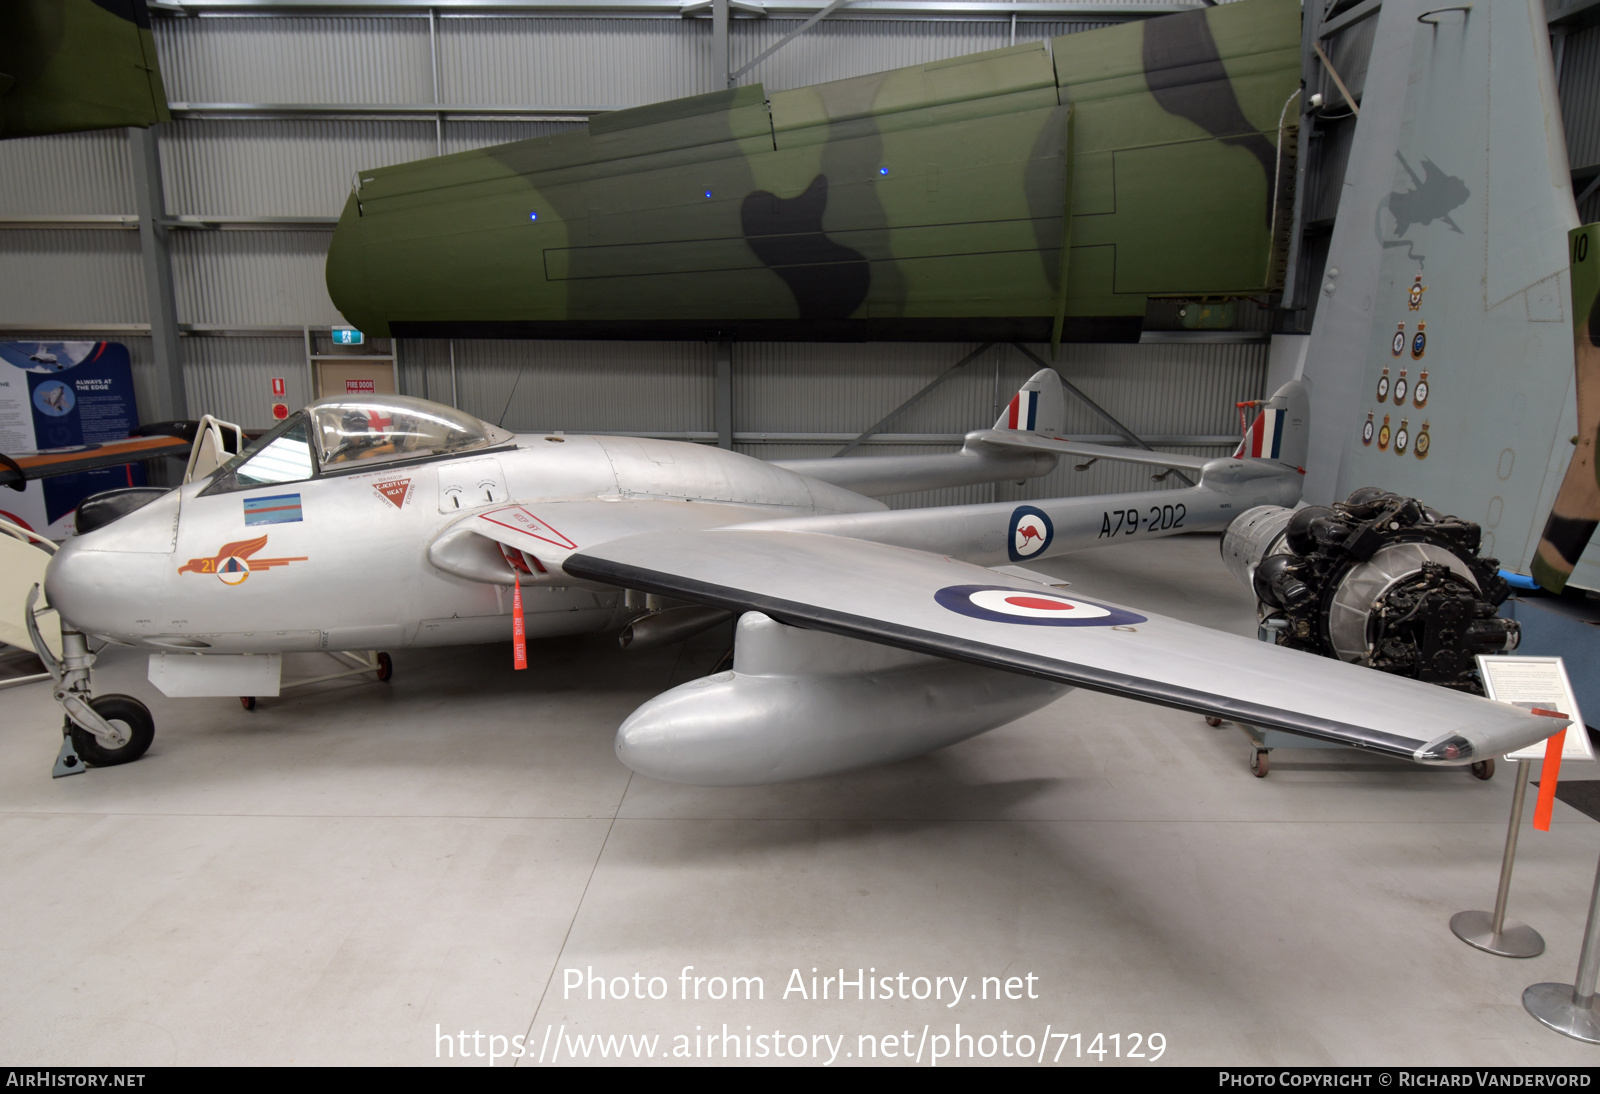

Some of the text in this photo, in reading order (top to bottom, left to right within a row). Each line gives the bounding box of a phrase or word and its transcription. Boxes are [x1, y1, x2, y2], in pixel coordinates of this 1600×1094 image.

[1573, 233, 1588, 264] 10
[375, 480, 409, 490] EJECTION
[387, 488, 404, 496] SEAT
[513, 513, 541, 532] KEEP OFF
[1098, 503, 1187, 539] A79-202
[201, 559, 216, 572] 21
[515, 618, 523, 636] BEFORE
[516, 643, 525, 661] FLIGHT
